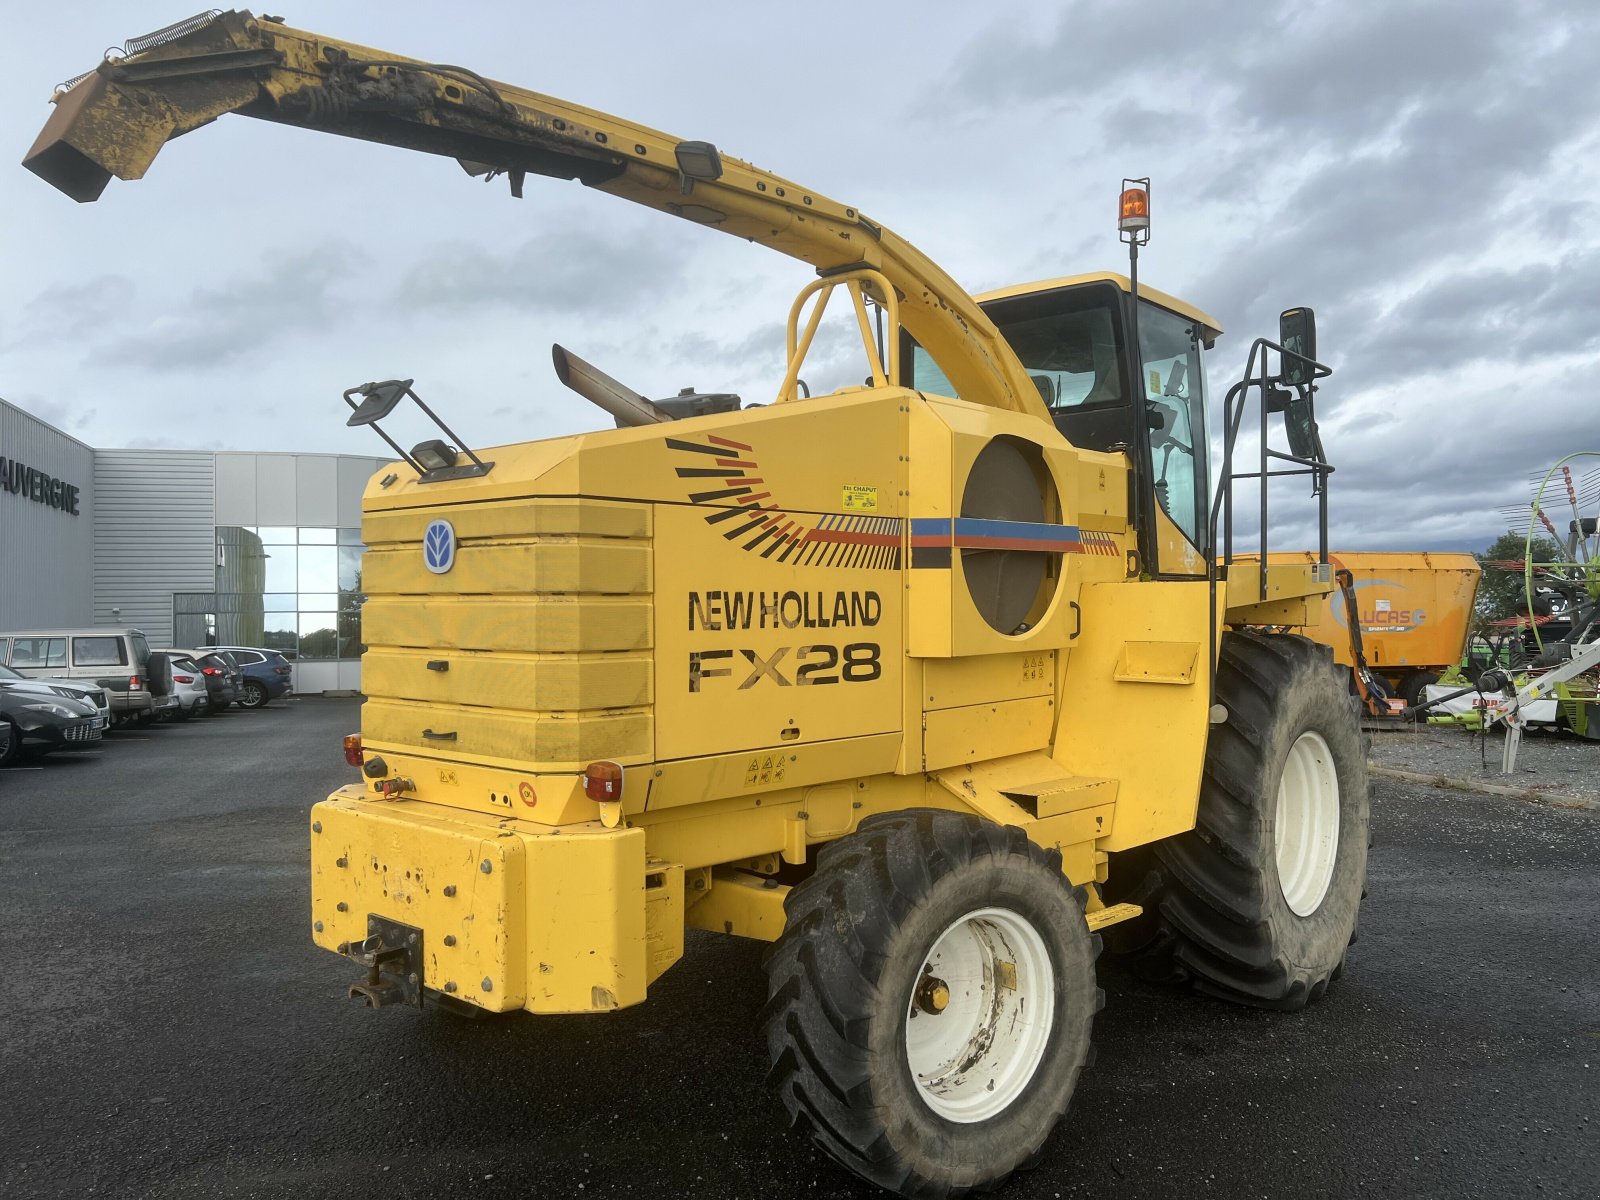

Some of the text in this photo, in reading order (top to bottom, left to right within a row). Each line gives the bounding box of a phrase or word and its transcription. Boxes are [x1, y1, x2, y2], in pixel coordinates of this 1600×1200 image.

[688, 590, 882, 631] NEW HOLLAND
[688, 642, 882, 693] FX28
